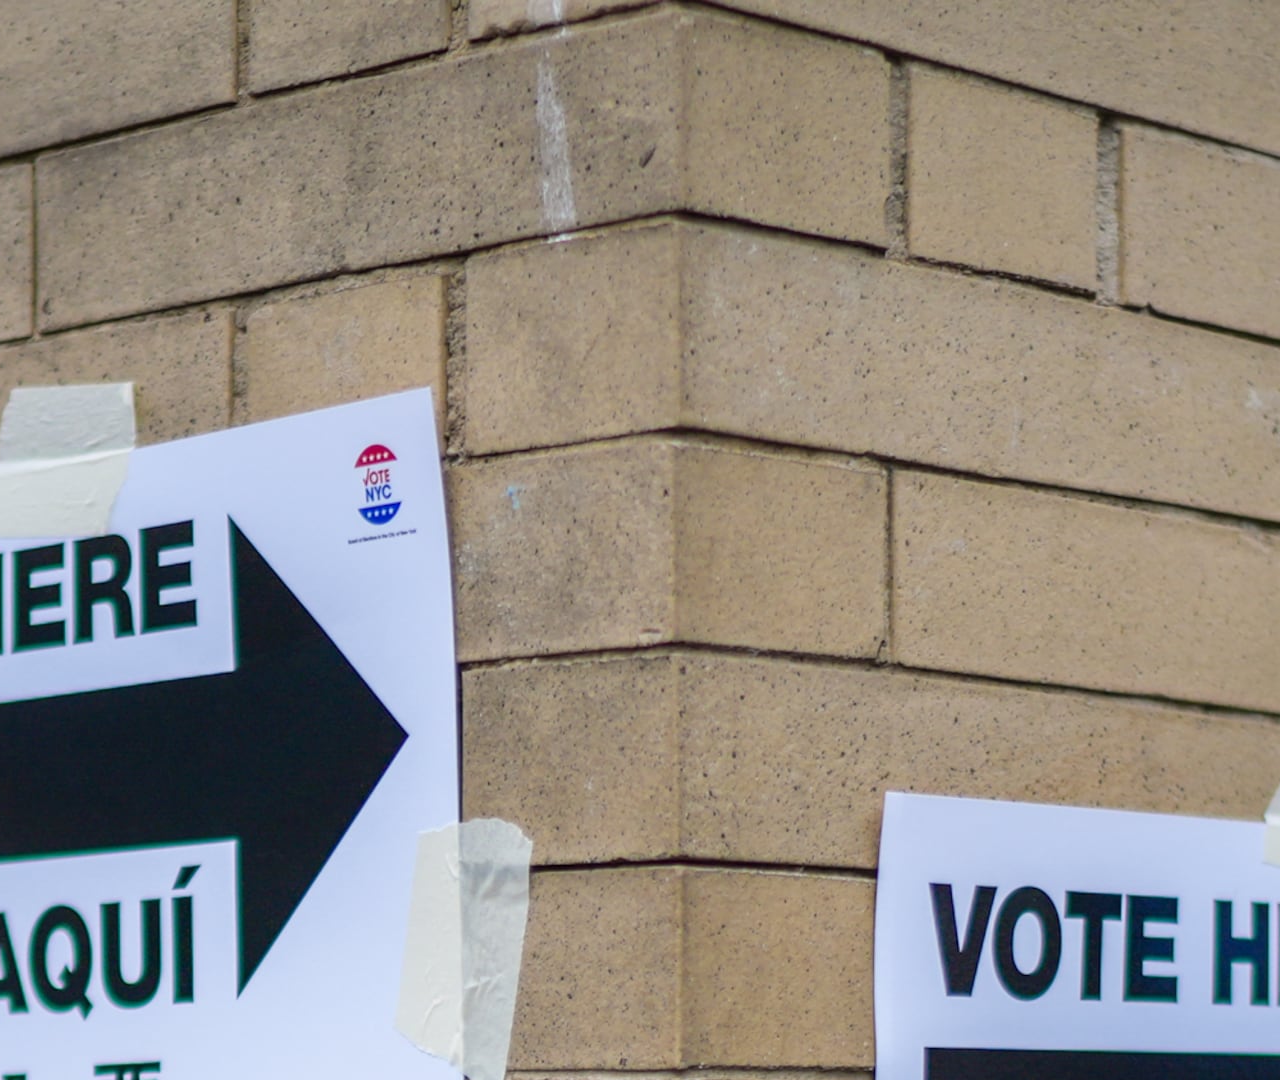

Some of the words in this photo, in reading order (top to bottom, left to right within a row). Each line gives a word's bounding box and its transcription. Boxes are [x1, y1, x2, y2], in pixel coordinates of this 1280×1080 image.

[362, 468, 390, 487] VOTE
[365, 484, 392, 502] NYC
[928, 881, 1180, 1003] VOTE
